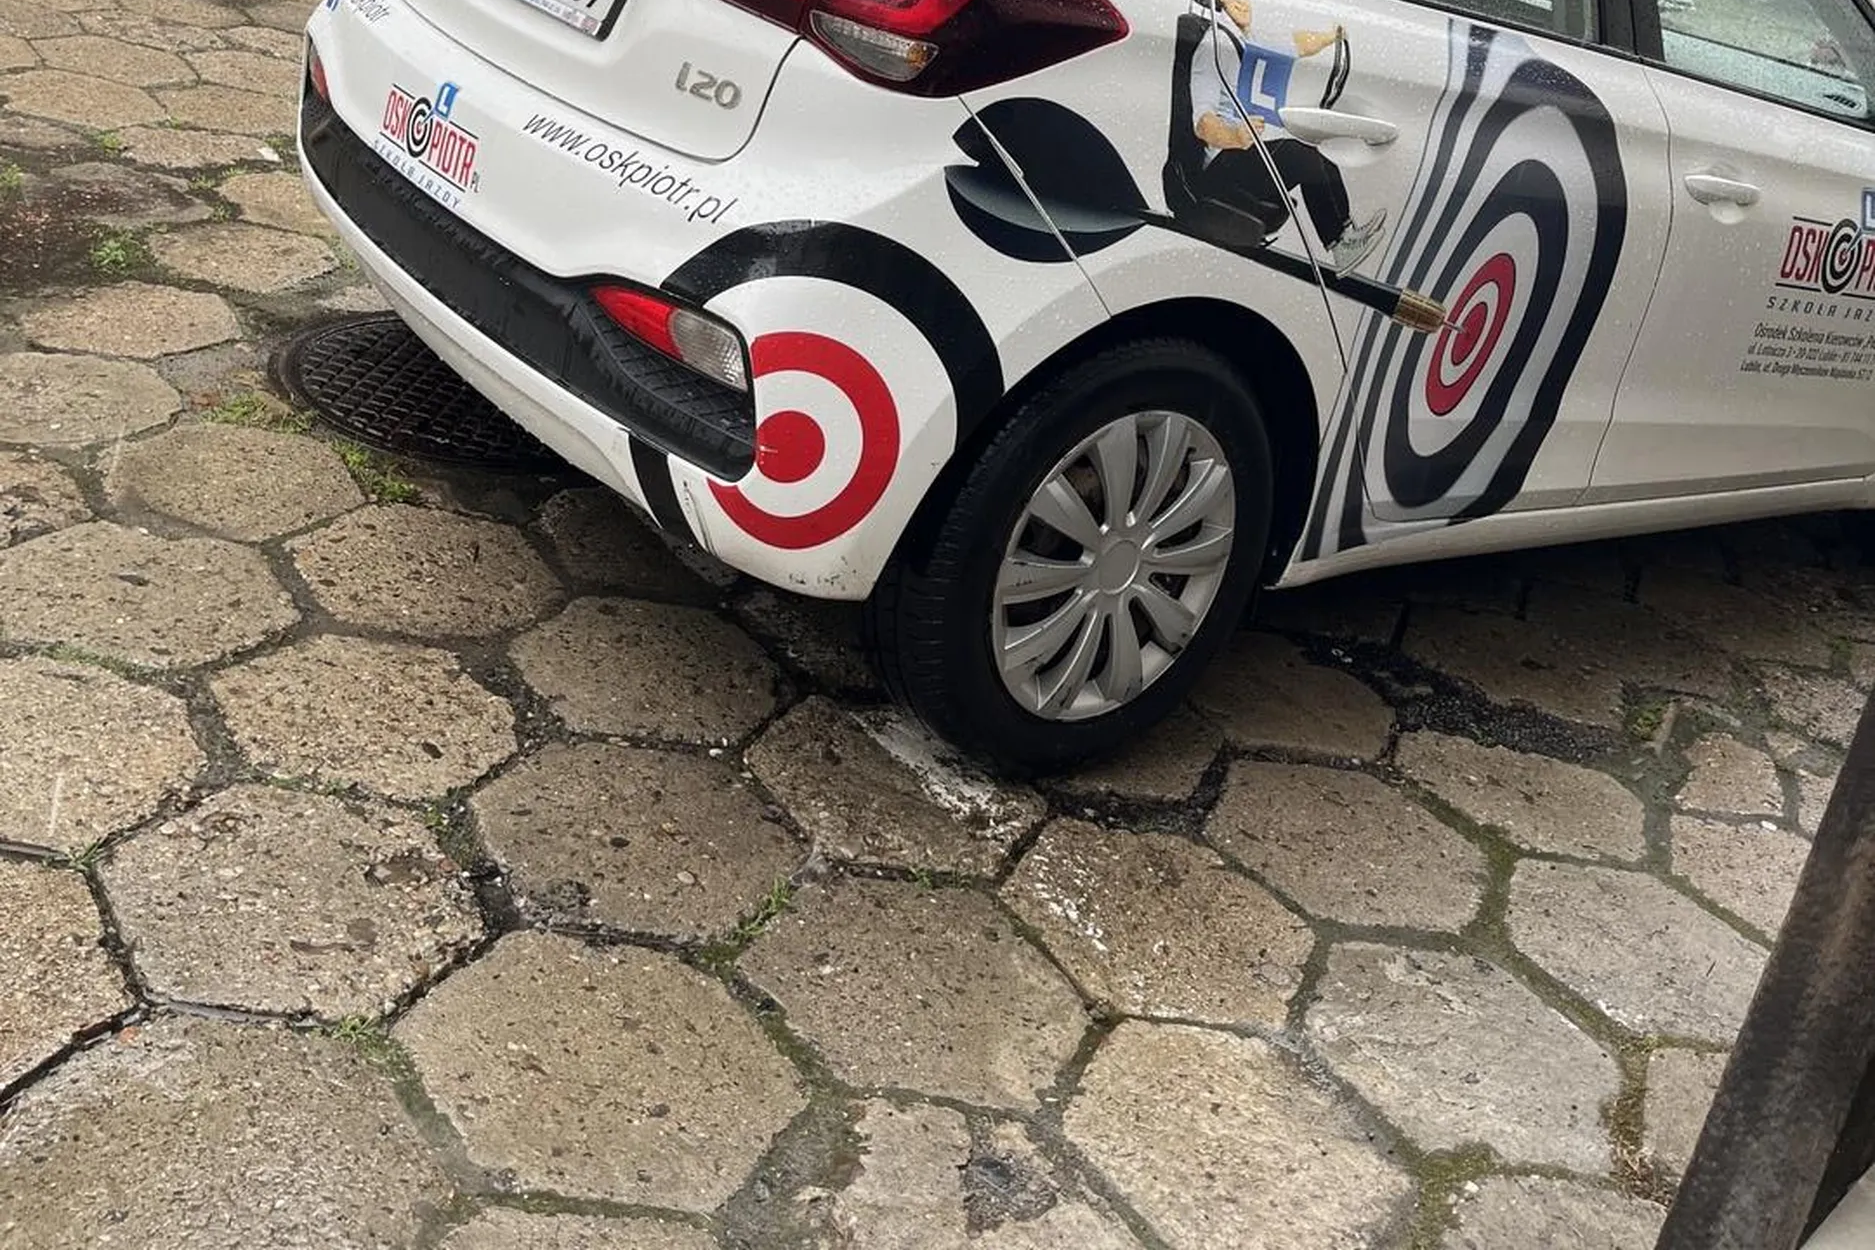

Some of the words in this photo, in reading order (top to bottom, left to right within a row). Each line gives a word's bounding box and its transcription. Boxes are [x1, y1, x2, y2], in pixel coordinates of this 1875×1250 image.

[1251, 58, 1277, 111] L
[383, 90, 413, 143] OSK
[427, 120, 476, 189] PIOTR
[522, 114, 739, 224] www.oskpiotr.pl
[1780, 225, 1830, 284] OSK
